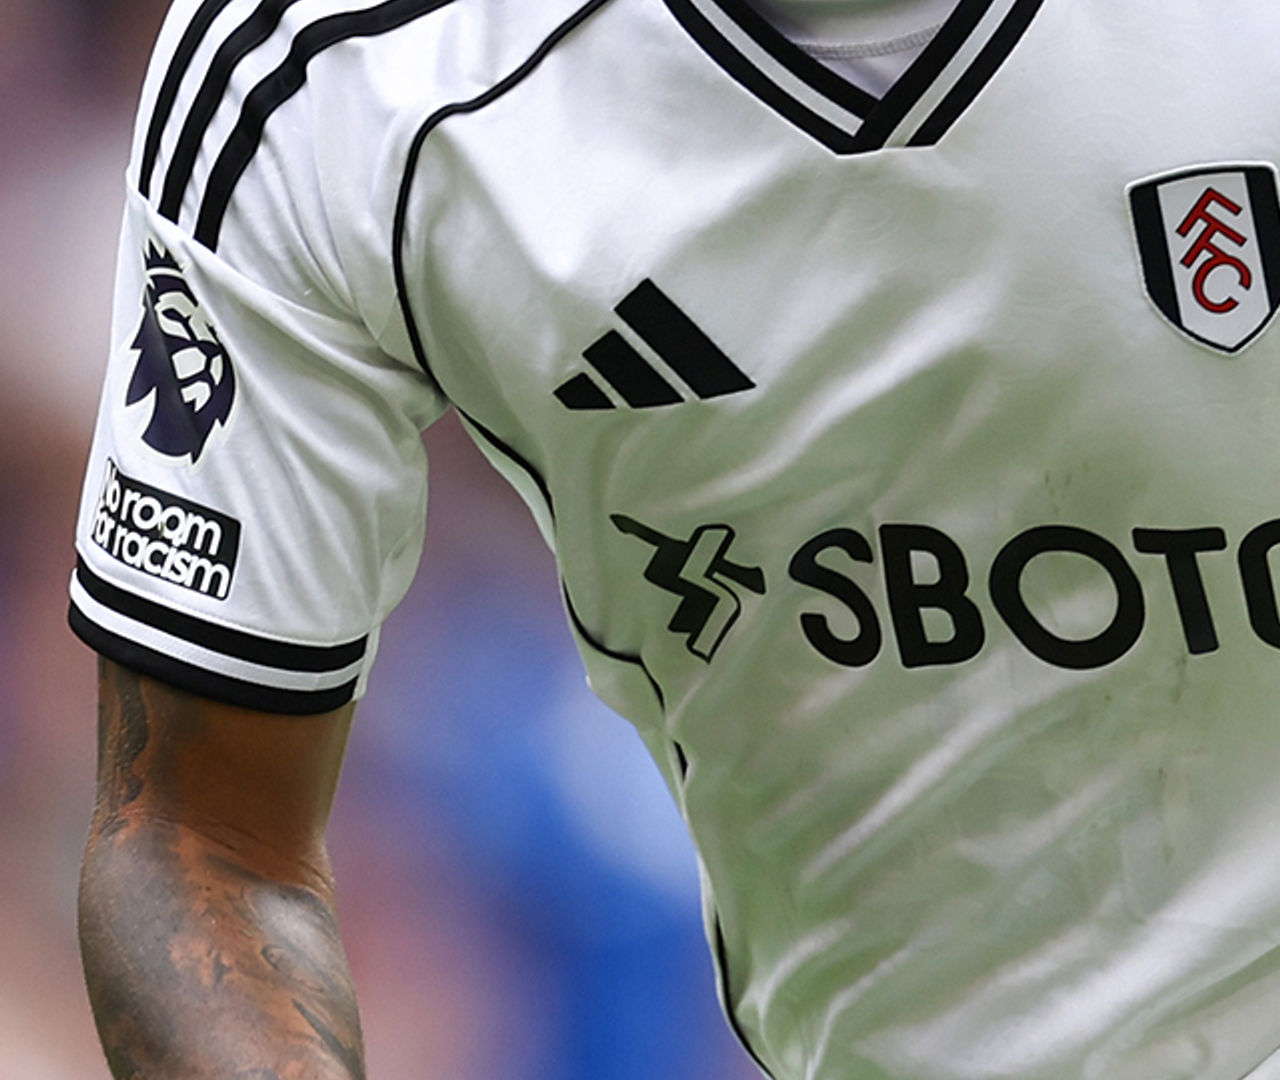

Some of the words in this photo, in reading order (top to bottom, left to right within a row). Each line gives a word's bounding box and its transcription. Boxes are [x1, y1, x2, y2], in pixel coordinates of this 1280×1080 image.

[1174, 186, 1253, 315] FFC
[120, 487, 222, 557] room
[112, 523, 230, 599] racism
